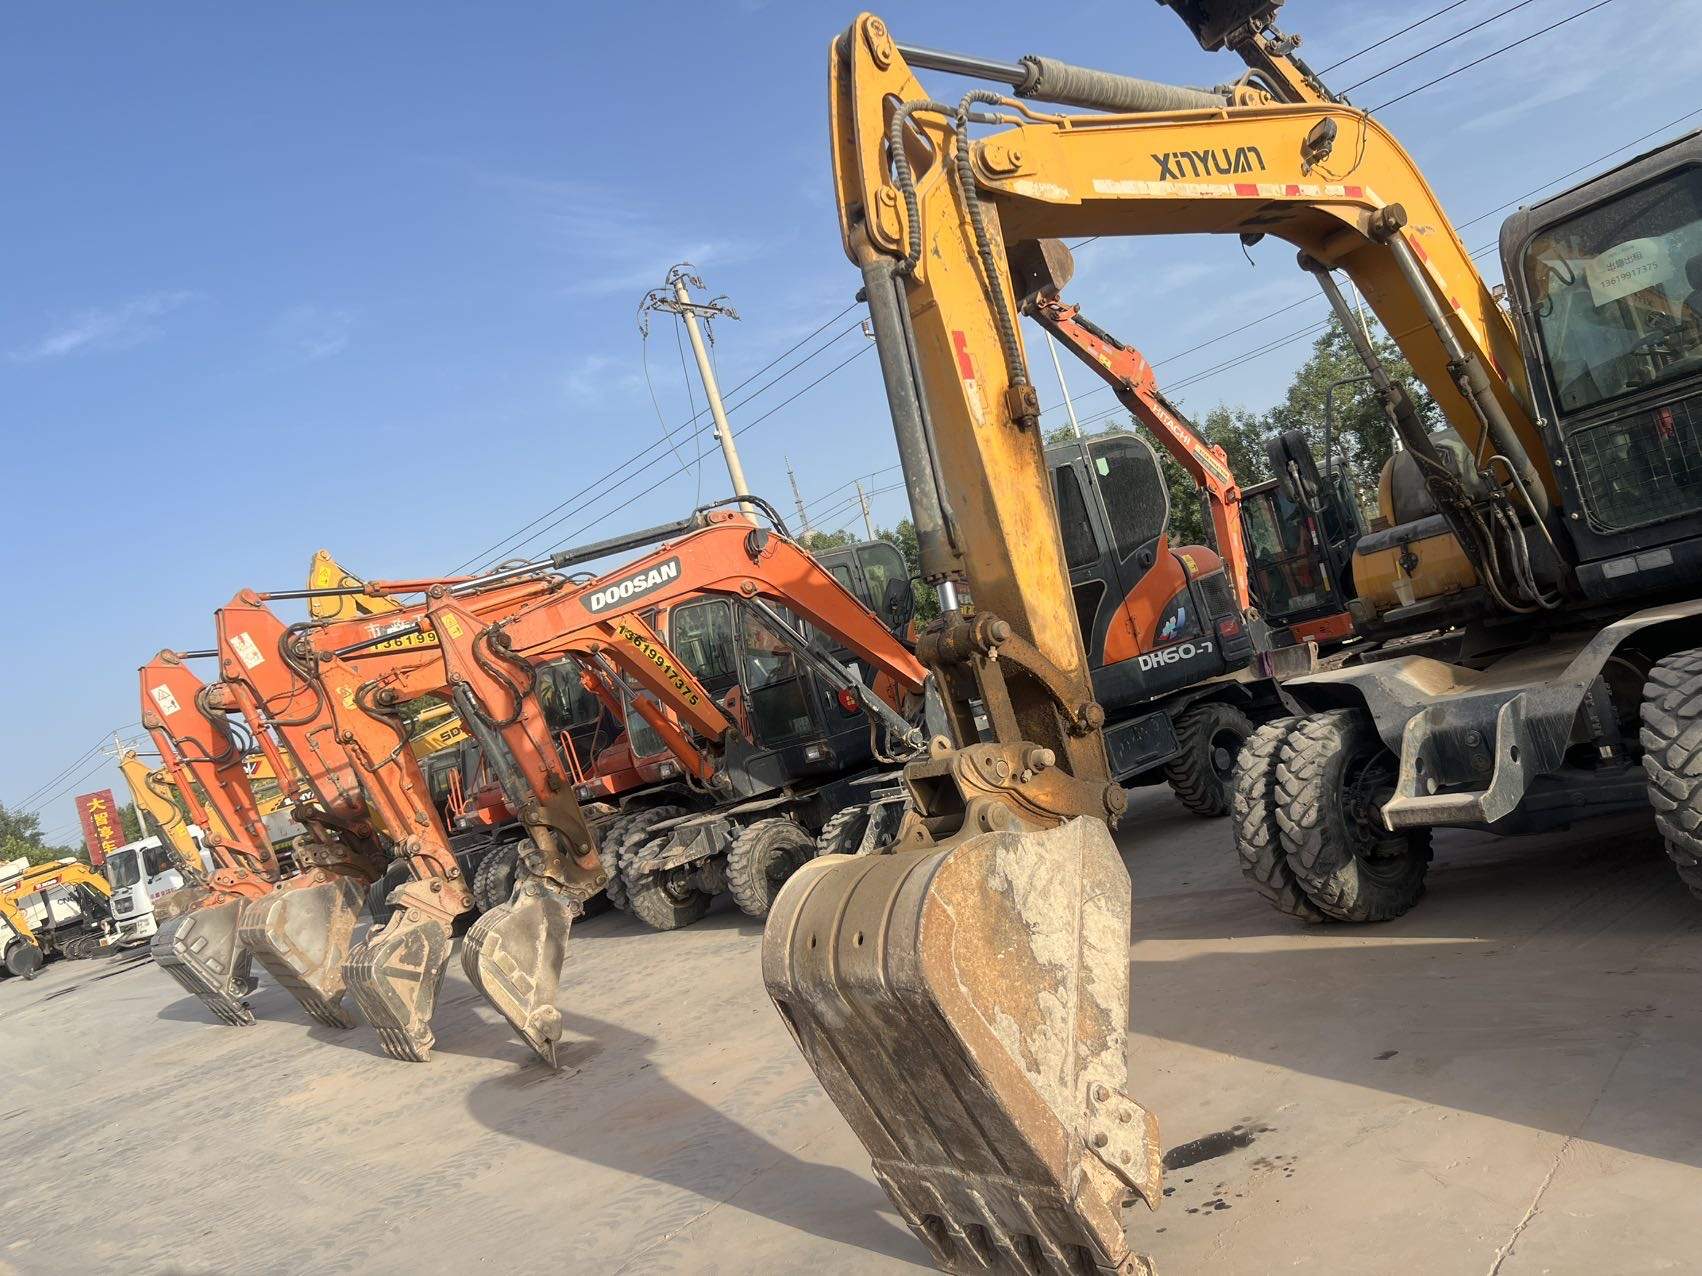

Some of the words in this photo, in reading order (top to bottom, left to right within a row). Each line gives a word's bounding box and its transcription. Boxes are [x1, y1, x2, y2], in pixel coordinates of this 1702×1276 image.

[1601, 262, 1658, 289] 13619917375
[1152, 404, 1191, 445] HITACHI
[590, 560, 679, 612] DOOSAN
[618, 625, 699, 706] 13619917375
[1138, 641, 1213, 672] DH60-7
